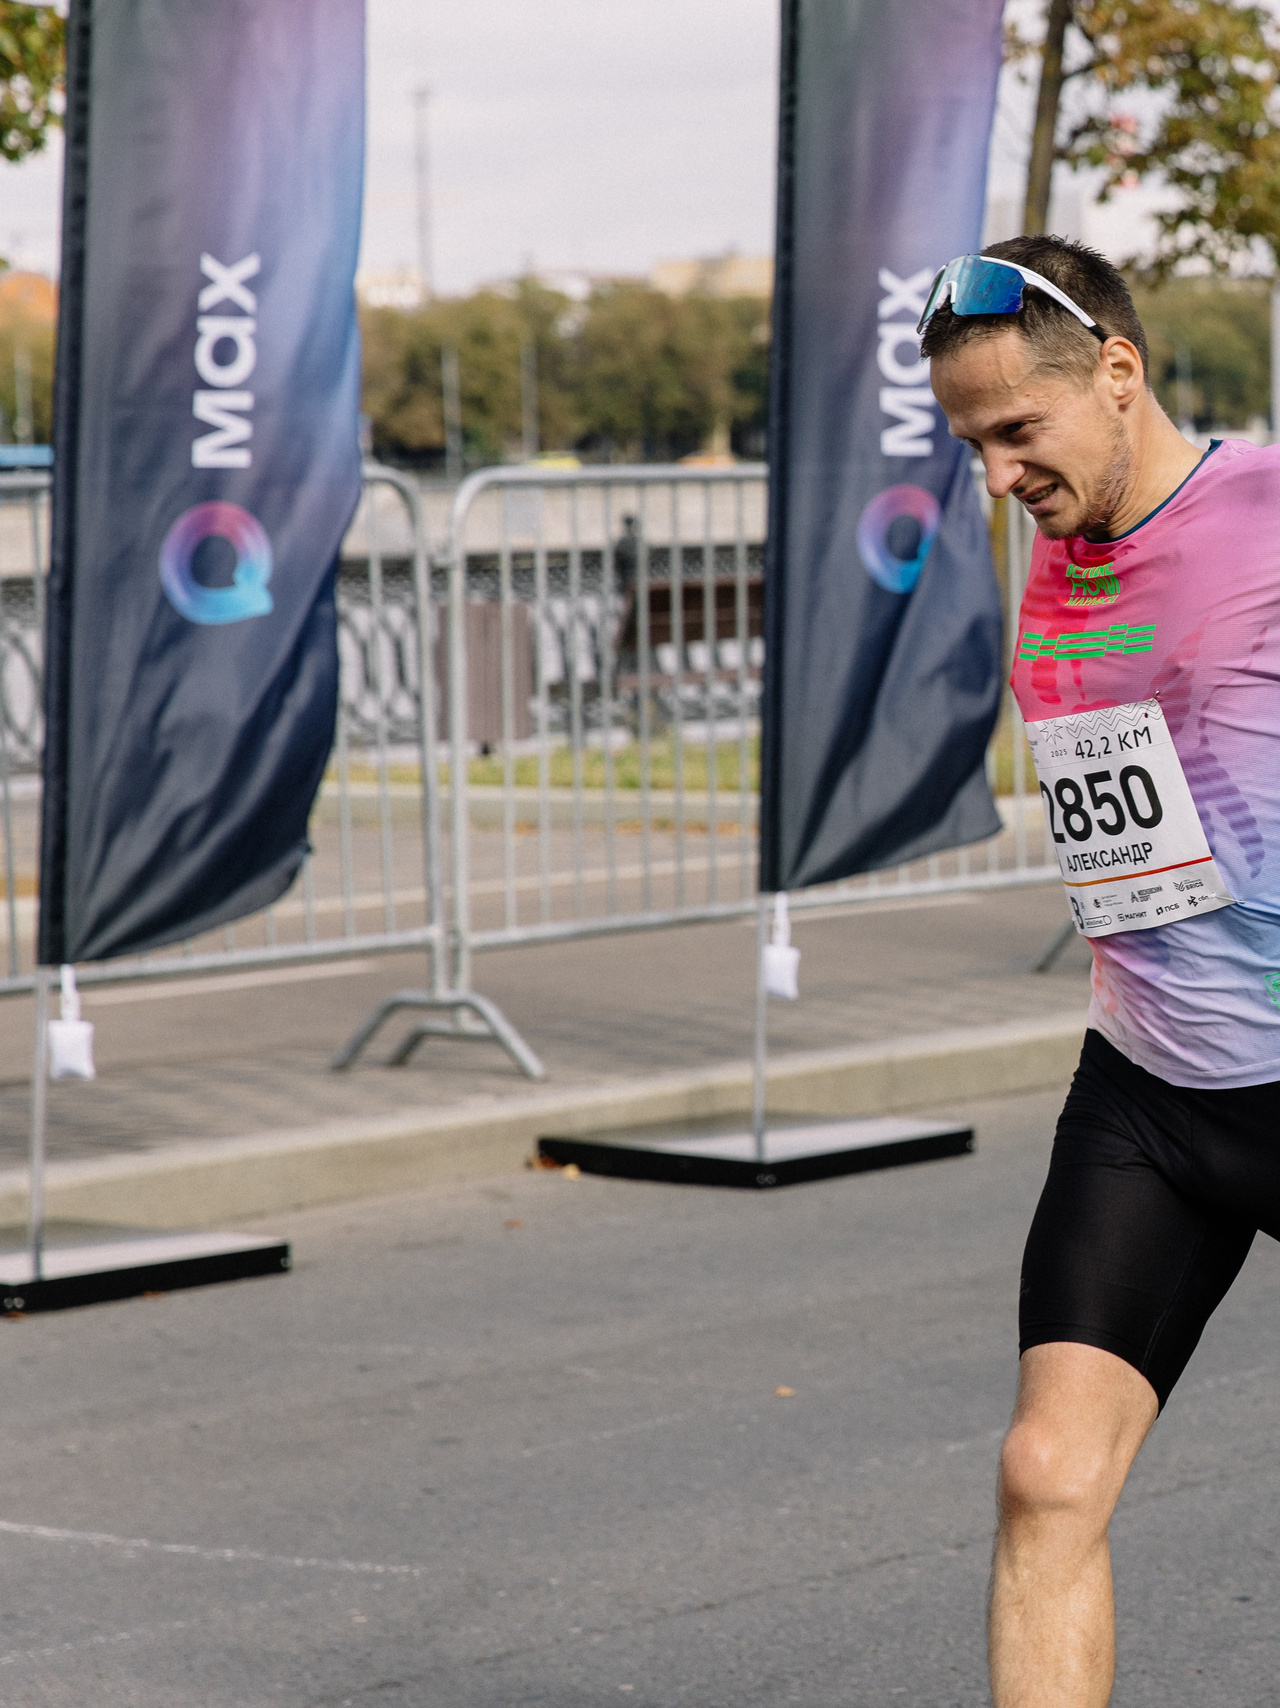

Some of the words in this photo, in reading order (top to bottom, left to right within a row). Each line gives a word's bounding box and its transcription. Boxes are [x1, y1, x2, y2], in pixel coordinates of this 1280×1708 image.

[1050, 748, 1068, 758] 2025
[1075, 736, 1112, 759] 42,2
[1039, 764, 1164, 844] 2850
[1066, 842, 1153, 872] АЛЕКСАНДР
[1125, 911, 1147, 920] МАГНИТ
[1164, 903, 1180, 912] ПСБ
